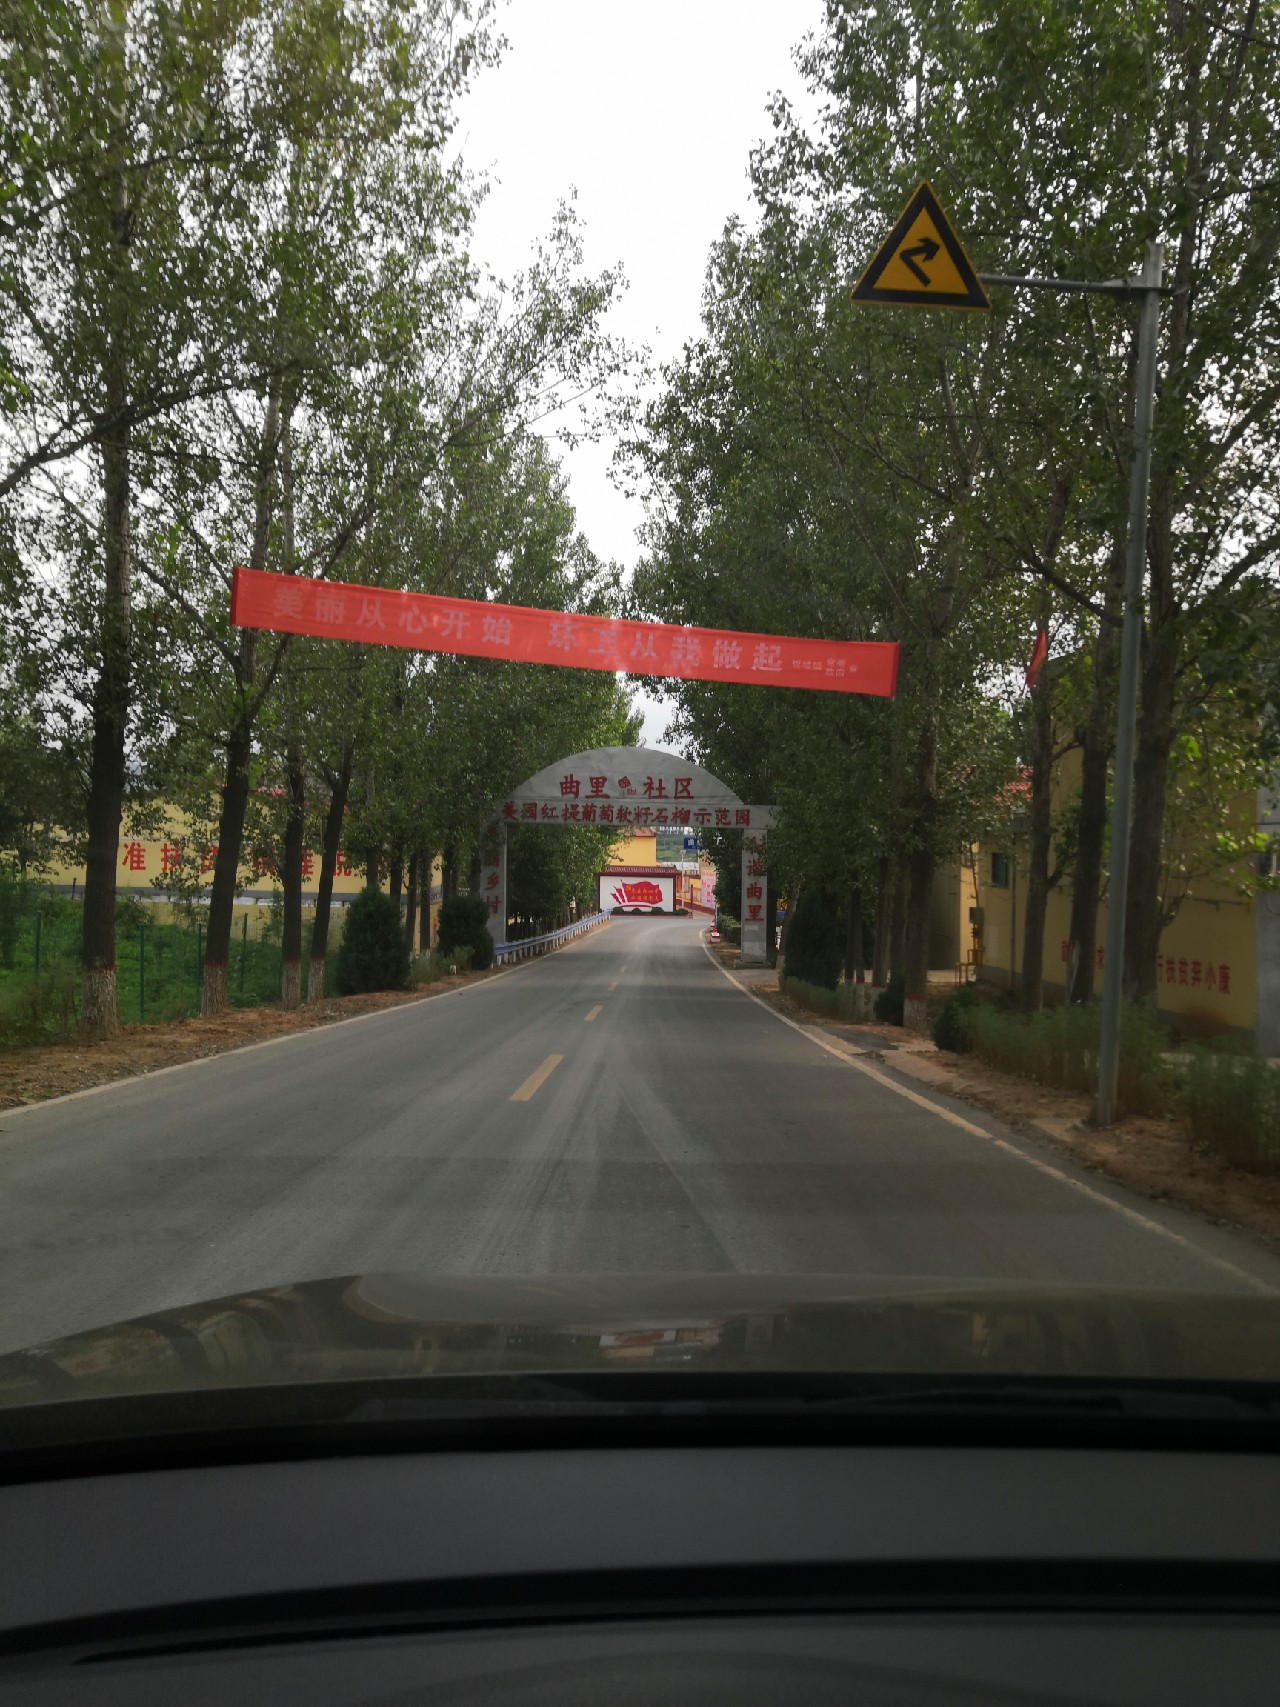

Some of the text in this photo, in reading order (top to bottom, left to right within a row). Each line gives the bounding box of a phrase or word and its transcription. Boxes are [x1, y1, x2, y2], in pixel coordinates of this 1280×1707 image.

[272, 586, 783, 673] 美丽从心开始 环卫从我做起
[559, 773, 695, 800] 曲里 社区
[502, 800, 751, 827] 美国红提葡萄软籽石榴示范园
